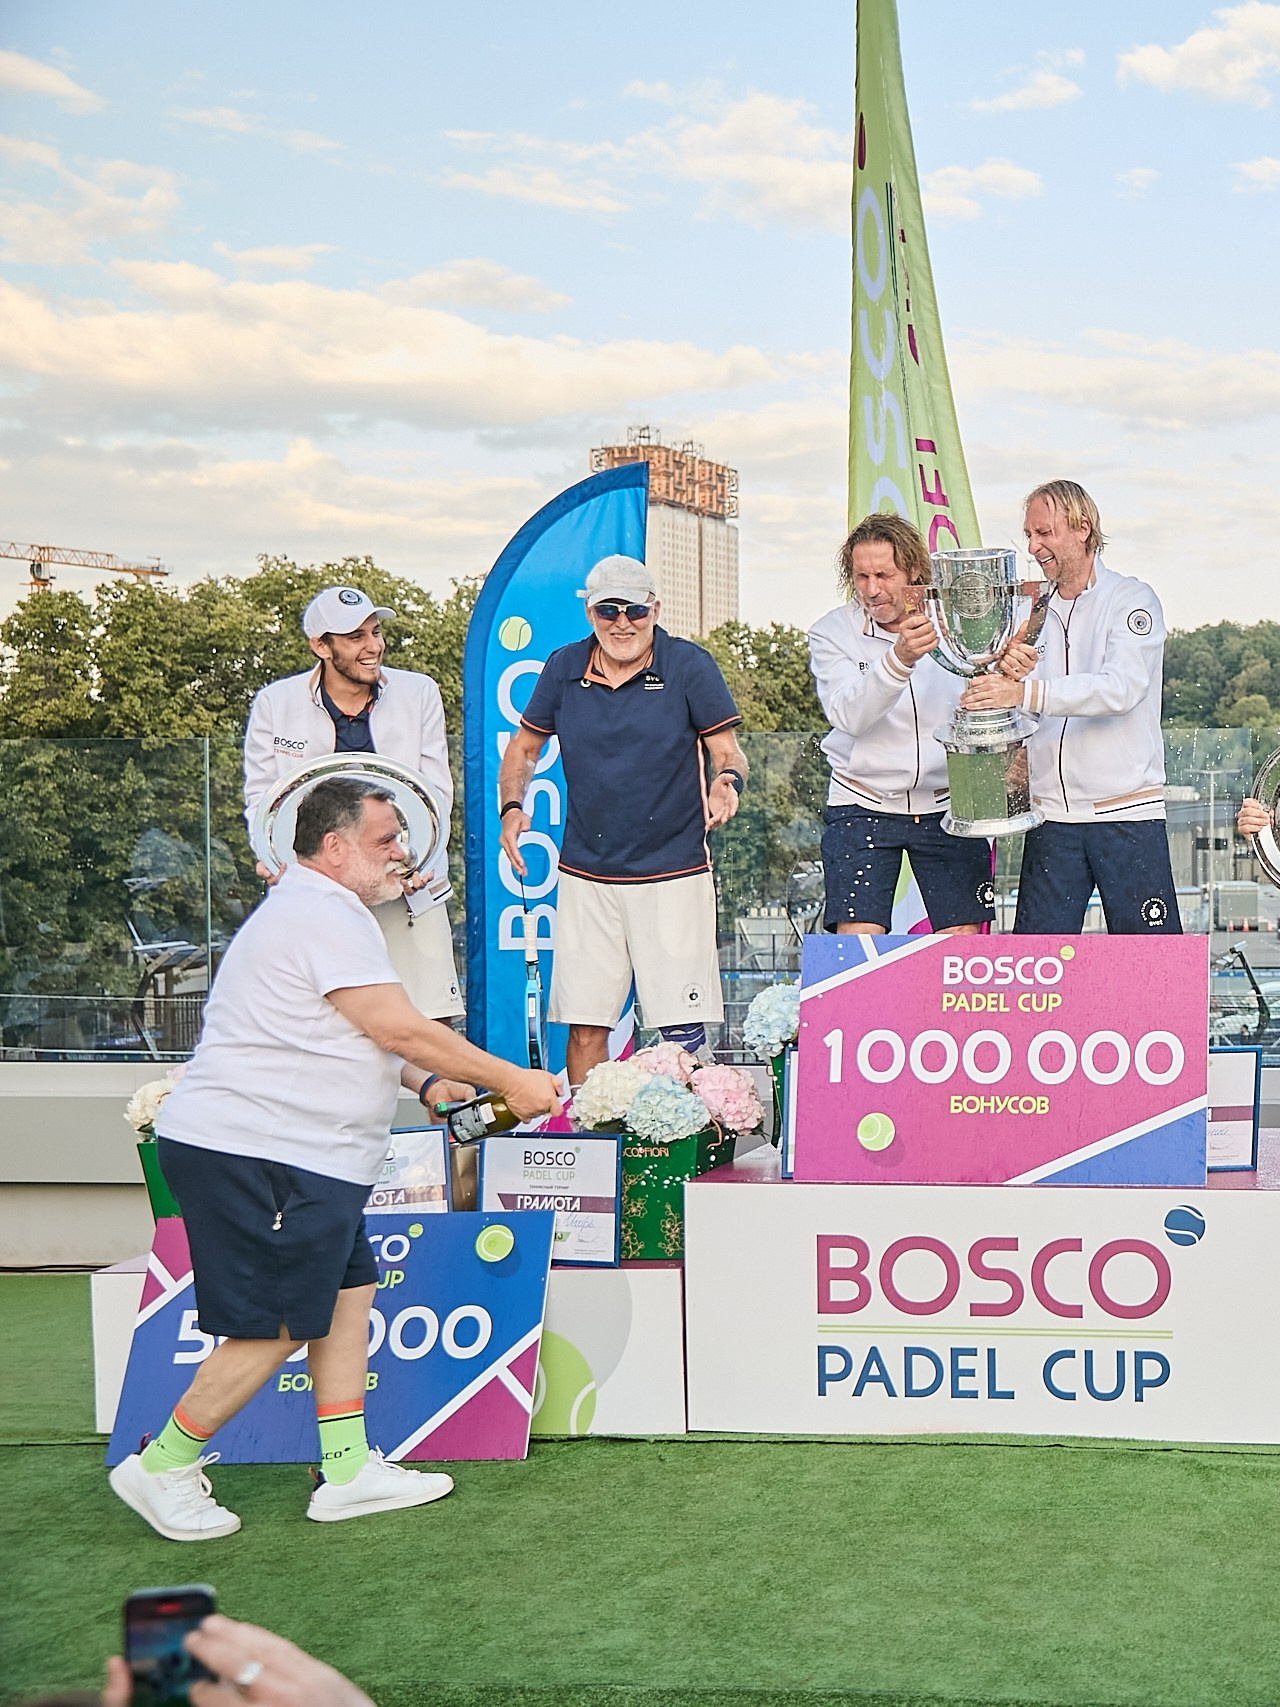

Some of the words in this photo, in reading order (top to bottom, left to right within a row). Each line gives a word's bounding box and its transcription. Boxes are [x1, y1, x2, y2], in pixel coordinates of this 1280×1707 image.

[273, 736, 305, 750] BOSCO
[943, 956, 1064, 985] BOSCO
[942, 993, 1010, 1013] PADEL
[1017, 994, 1063, 1013] CUP
[1027, 1030, 1185, 1086] 000
[949, 1095, 1050, 1115] БОНУСОВ
[523, 1150, 576, 1167] BOSCO
[381, 1165, 397, 1176] UP
[523, 1169, 553, 1181] PADEL
[555, 1171, 576, 1181] CUP
[516, 1194, 581, 1212] ГРАМОТА
[376, 1270, 405, 1289] UP
[816, 1234, 1172, 1320] BOSCO
[816, 1344, 1016, 1401] PADEL
[1042, 1349, 1171, 1403] CUP
